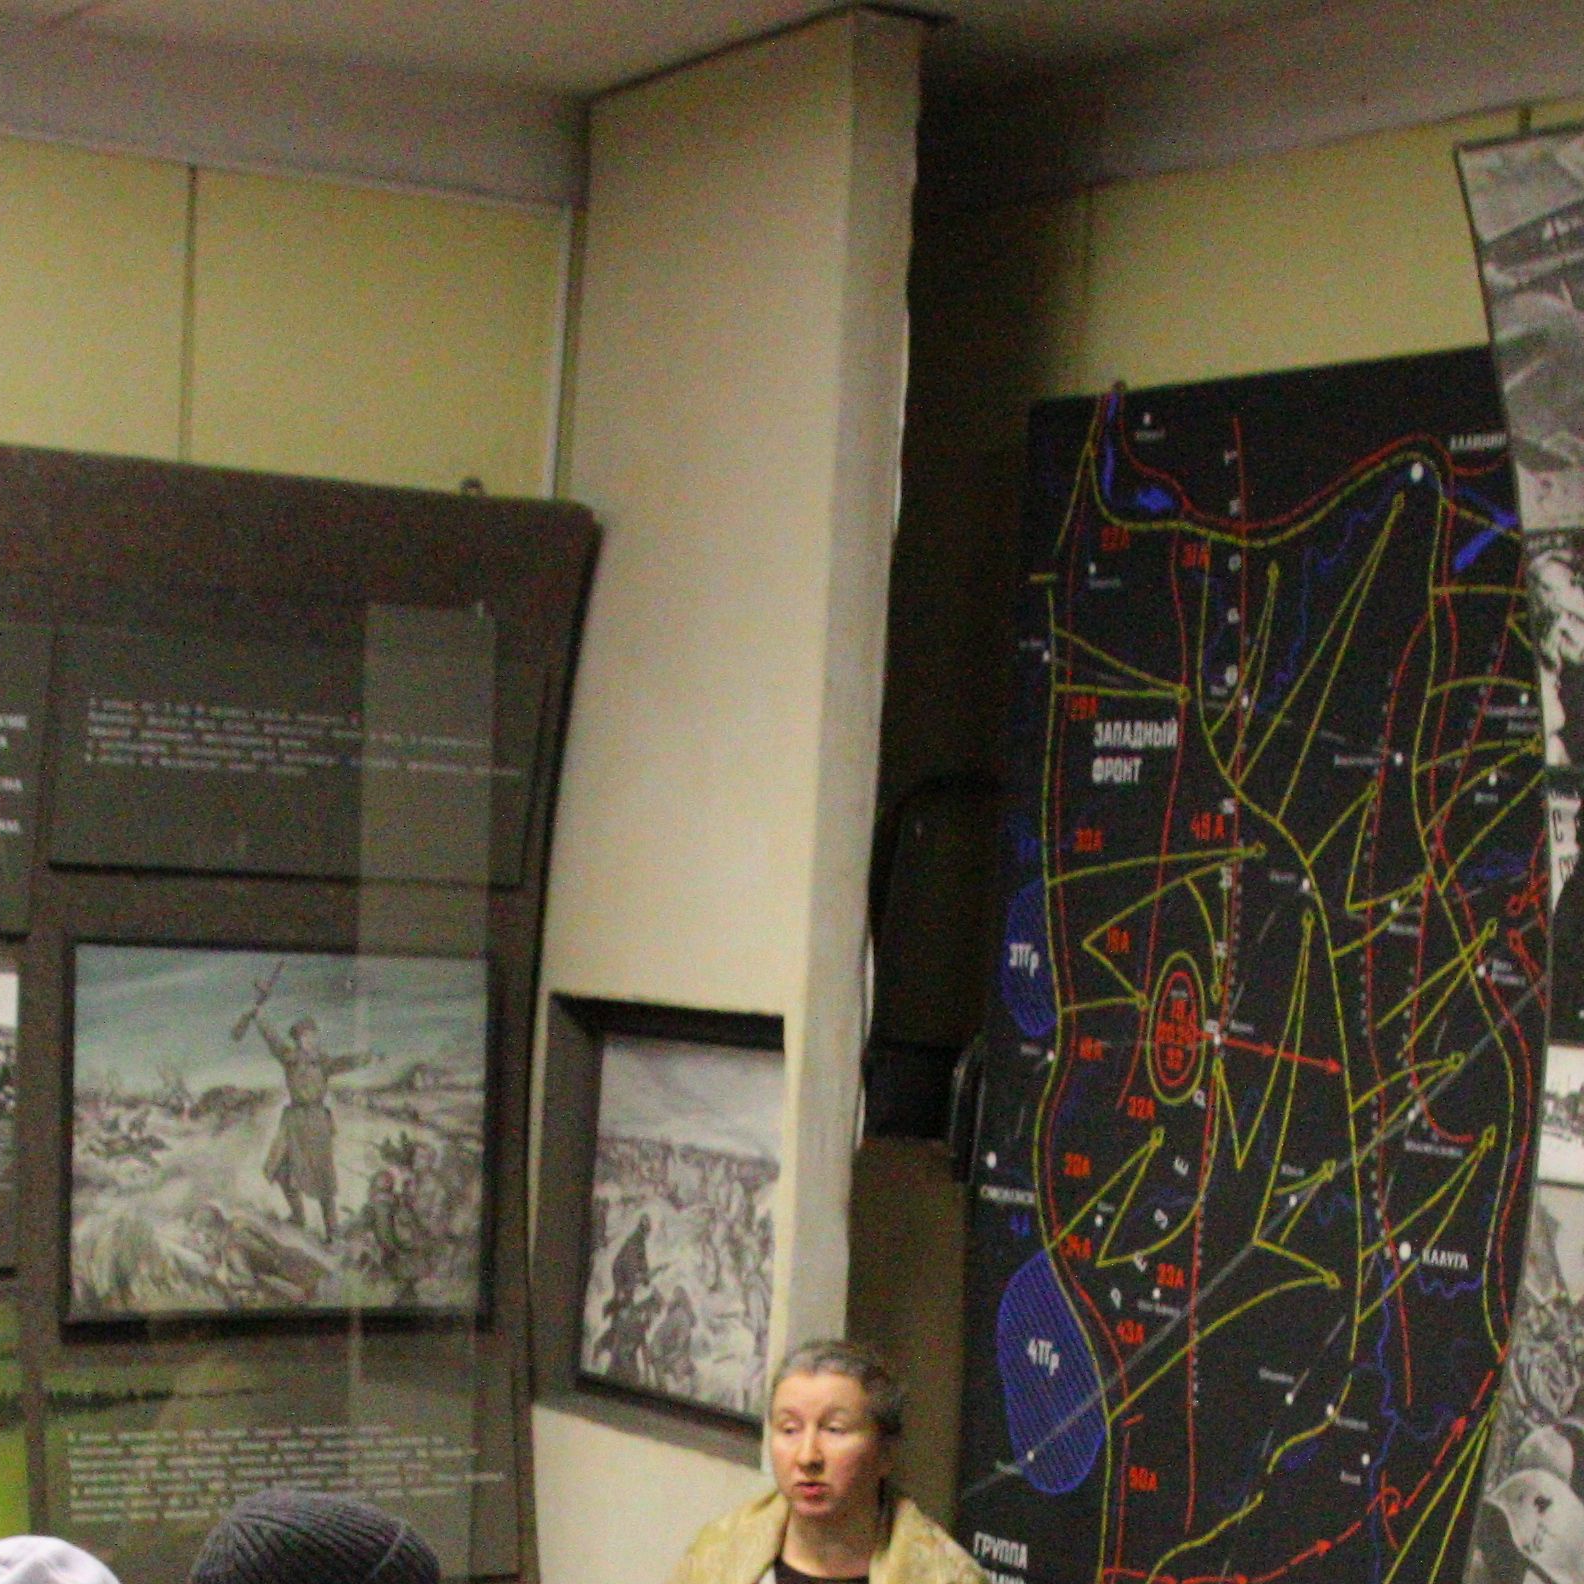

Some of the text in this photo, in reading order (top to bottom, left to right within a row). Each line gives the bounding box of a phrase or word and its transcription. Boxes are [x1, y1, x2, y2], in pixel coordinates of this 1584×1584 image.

[1093, 718, 1179, 749] ЗАПАДНЫЙ
[1091, 756, 1144, 784] ФРОНТ
[973, 1531, 1029, 1571] ГРУППА
